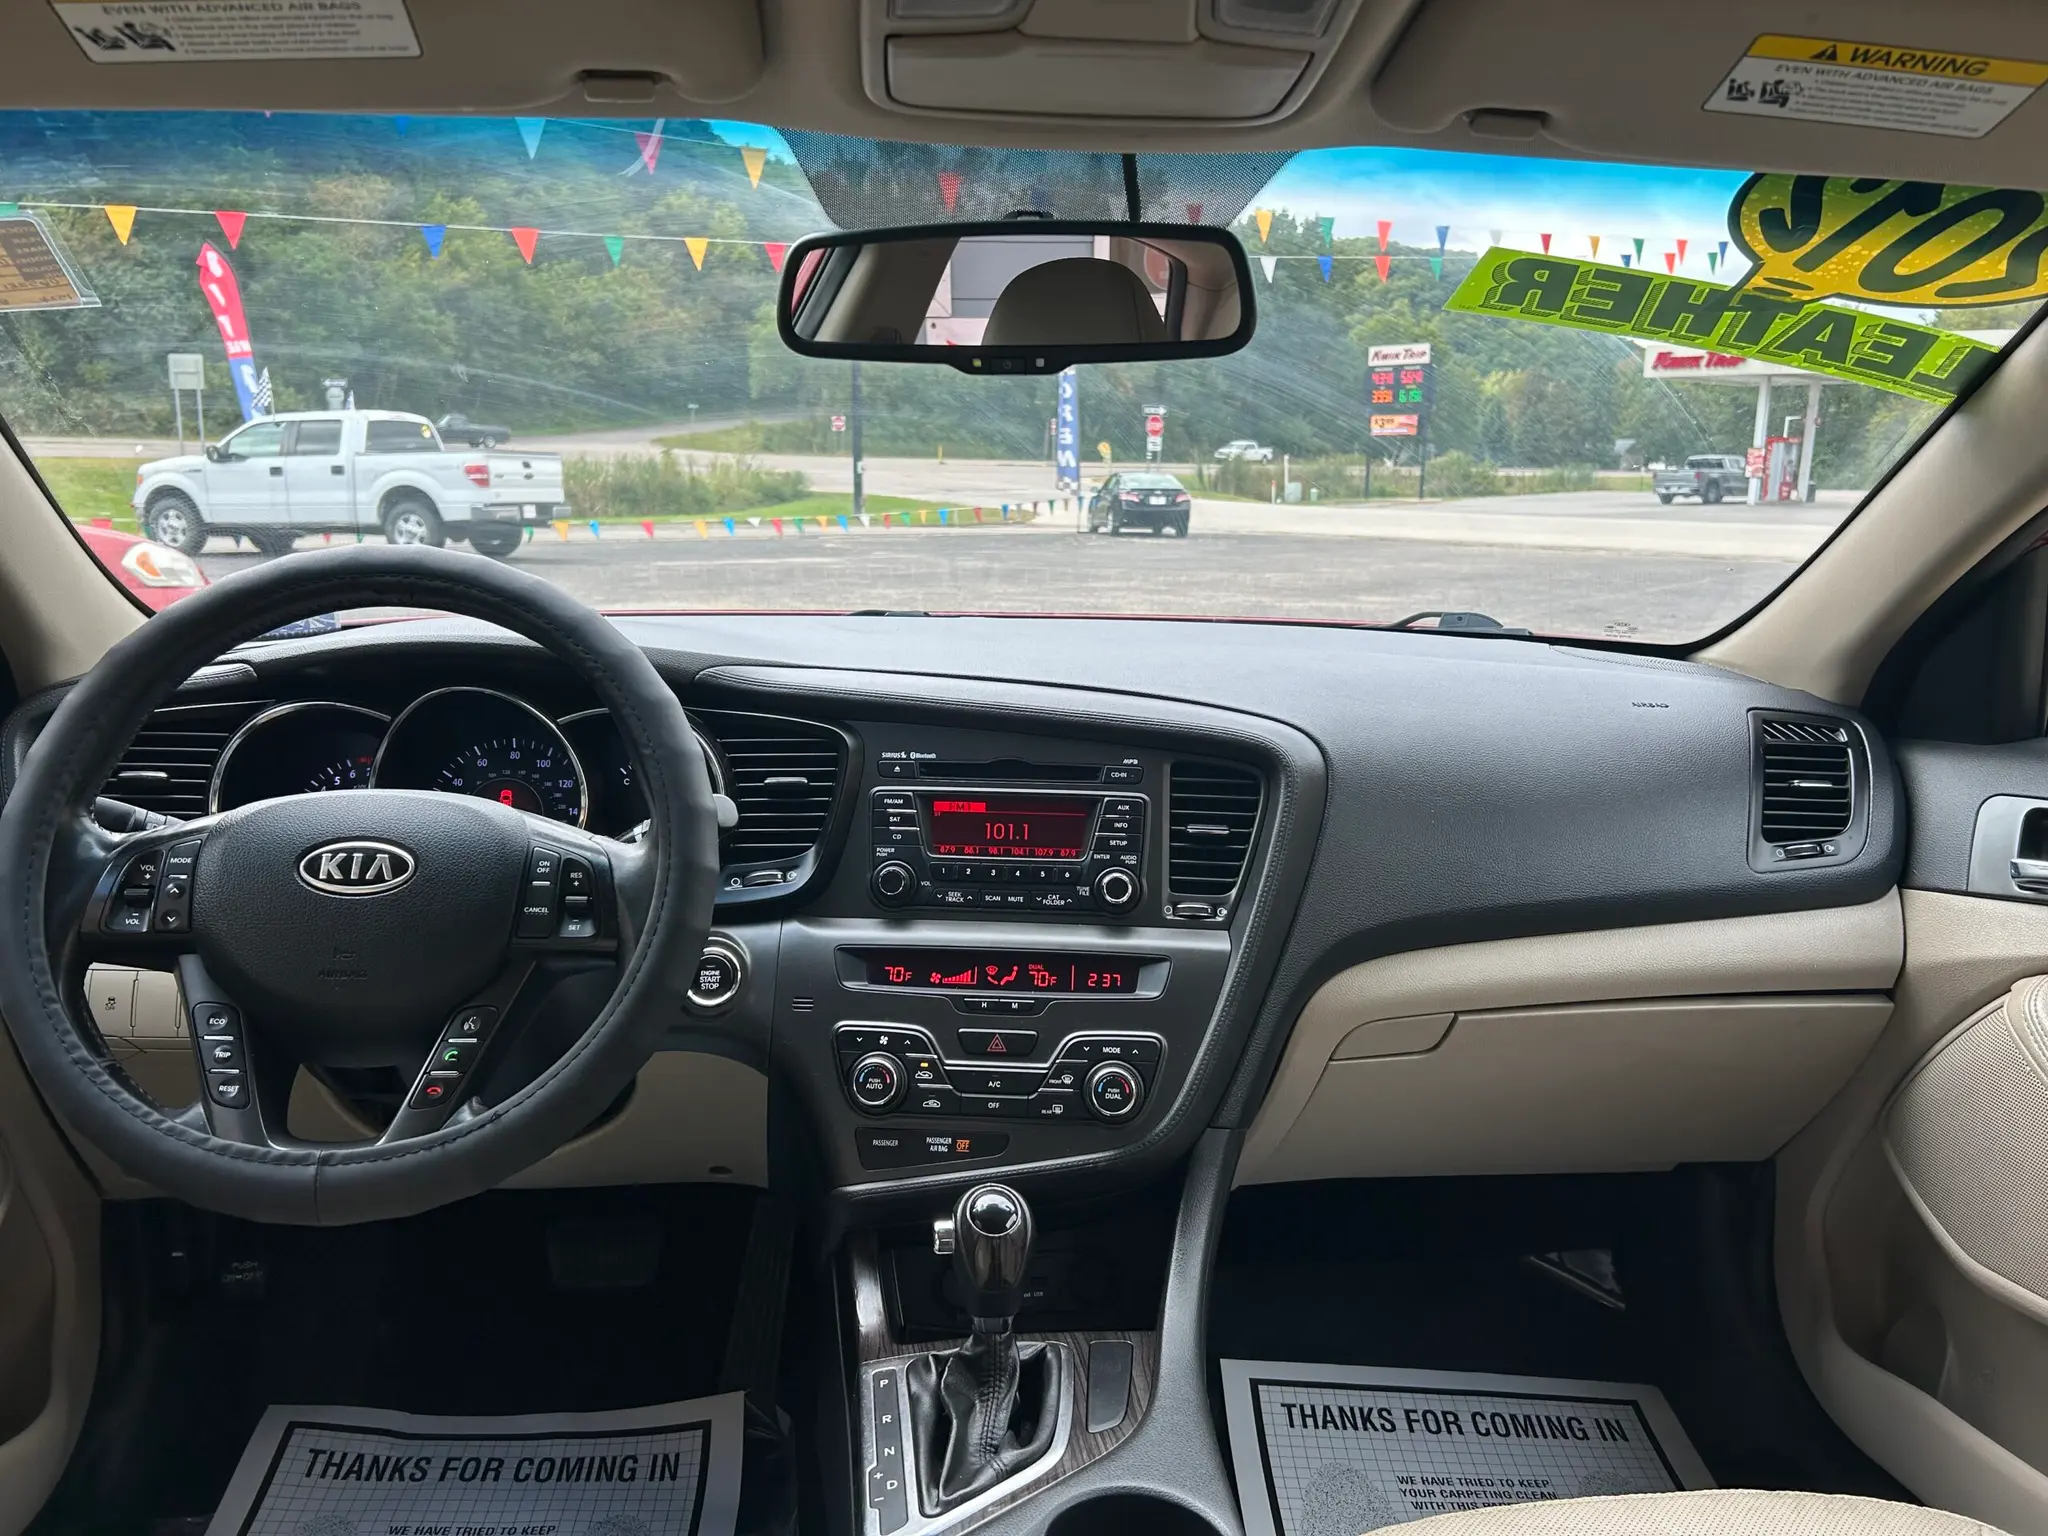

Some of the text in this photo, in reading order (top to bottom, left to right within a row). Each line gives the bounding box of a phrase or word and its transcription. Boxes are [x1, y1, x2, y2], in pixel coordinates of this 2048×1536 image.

[104, 1, 362, 15] EVEN WITH ADVANCED AIR BAGS
[1850, 47, 1990, 76] WARNING
[1774, 64, 1994, 95] EVEN WITH ADVANCED AIR BAGS
[509, 751, 521, 760] 80
[477, 759, 551, 768] 60 100
[349, 769, 356, 778] 6
[334, 776, 341, 786] 5
[452, 777, 573, 788] 40 120
[623, 777, 631, 786] C
[985, 823, 1028, 840] 101.1
[319, 853, 393, 880] KIA
[1040, 870, 1046, 878] 5
[1102, 1046, 1121, 1054] MODE
[988, 1080, 1001, 1088] A/C
[872, 1139, 899, 1147] PASSENGER
[926, 1136, 952, 1145] PASSENGER
[956, 1141, 970, 1150] OFF
[879, 1379, 889, 1388] P
[882, 1414, 892, 1424] R
[1281, 1402, 1631, 1443] THANKS FOR COMING IN
[884, 1446, 896, 1457] N
[304, 1448, 682, 1482] THANKS FOR COMING IN
[887, 1479, 898, 1490] D
[1396, 1475, 1550, 1489] WE HAVE TRIED TO KEEP
[1399, 1488, 1559, 1501] YOUR CARPETING CLEAN
[1410, 1501, 1448, 1511] WITH
[1449, 1502, 1479, 1510] THIS
[389, 1524, 557, 1536] WE HAVE TRIED TO KEEP
